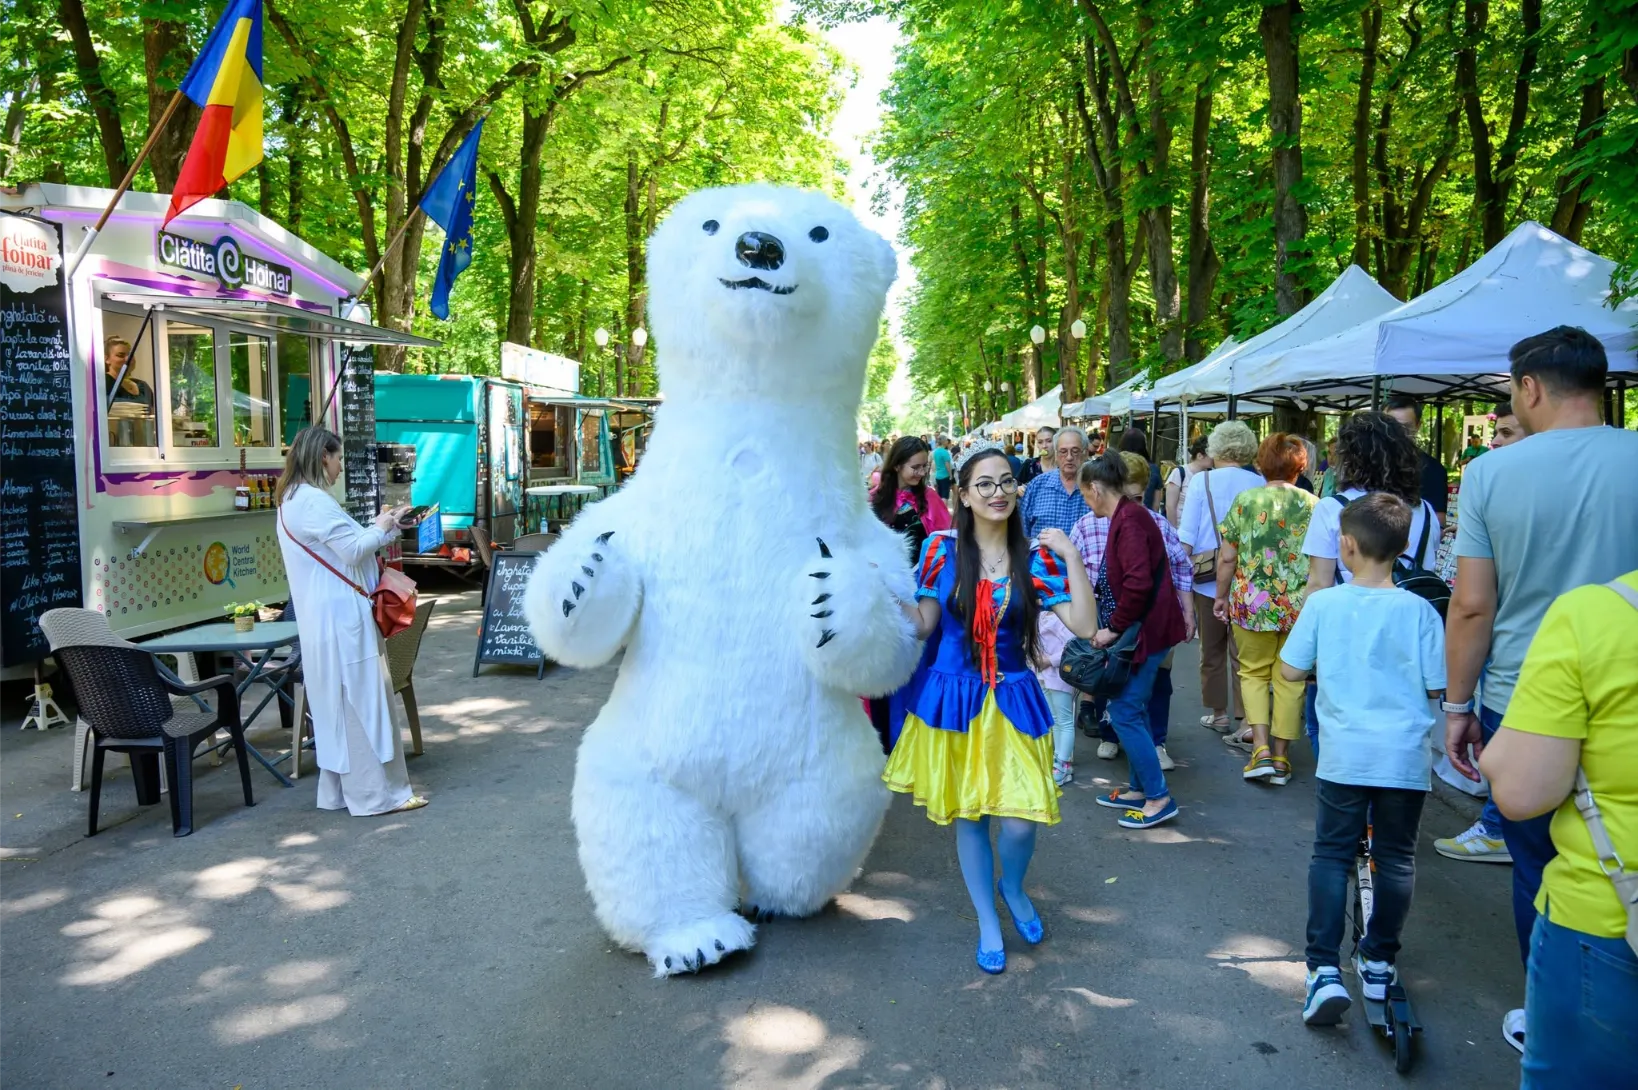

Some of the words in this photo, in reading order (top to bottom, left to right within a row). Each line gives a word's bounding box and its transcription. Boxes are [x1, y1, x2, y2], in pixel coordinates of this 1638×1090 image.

[245, 258, 291, 292] Hoinar
[231, 544, 250, 554] World
[232, 555, 255, 567] Central
[233, 566, 257, 578] Kitchen
